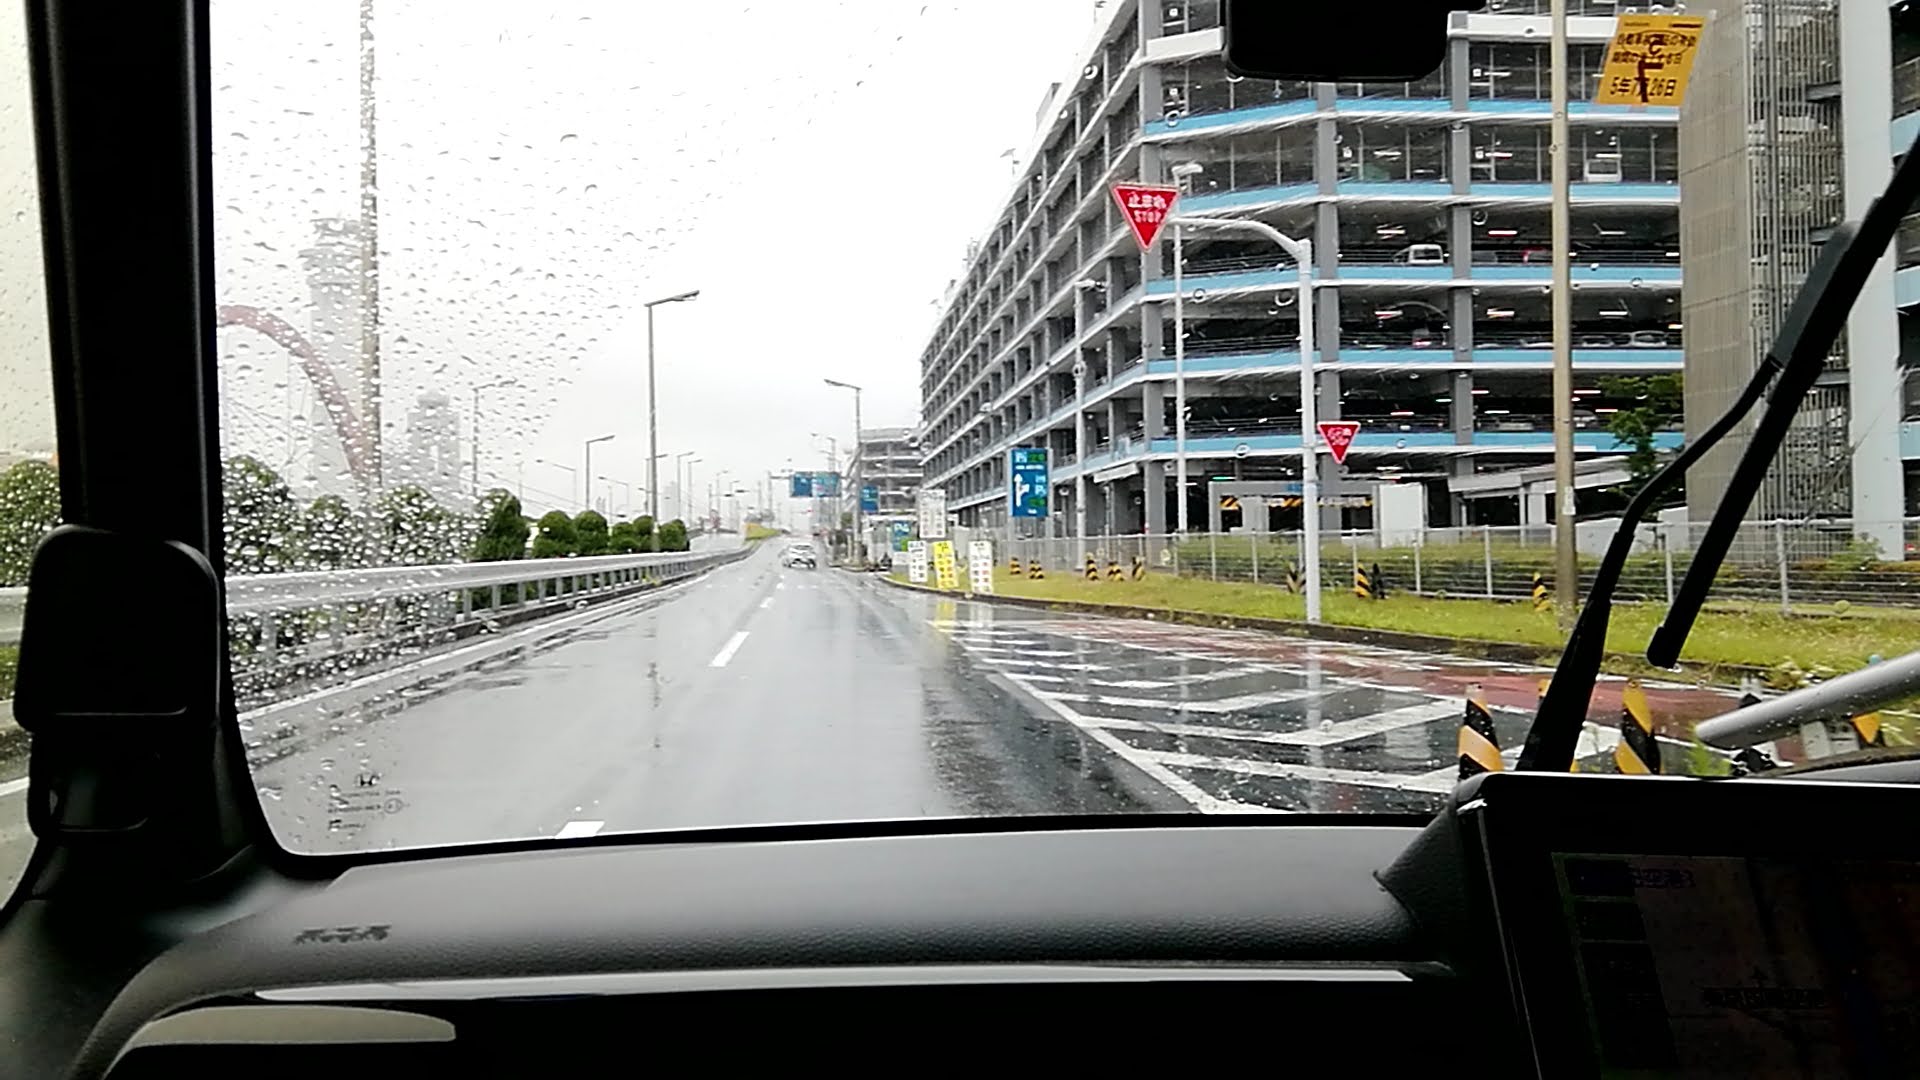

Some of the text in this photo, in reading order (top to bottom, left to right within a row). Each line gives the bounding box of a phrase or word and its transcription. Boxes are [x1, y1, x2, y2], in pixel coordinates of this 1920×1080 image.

[1127, 191, 1167, 208] 止まれ
[1134, 209, 1162, 223] STOP
